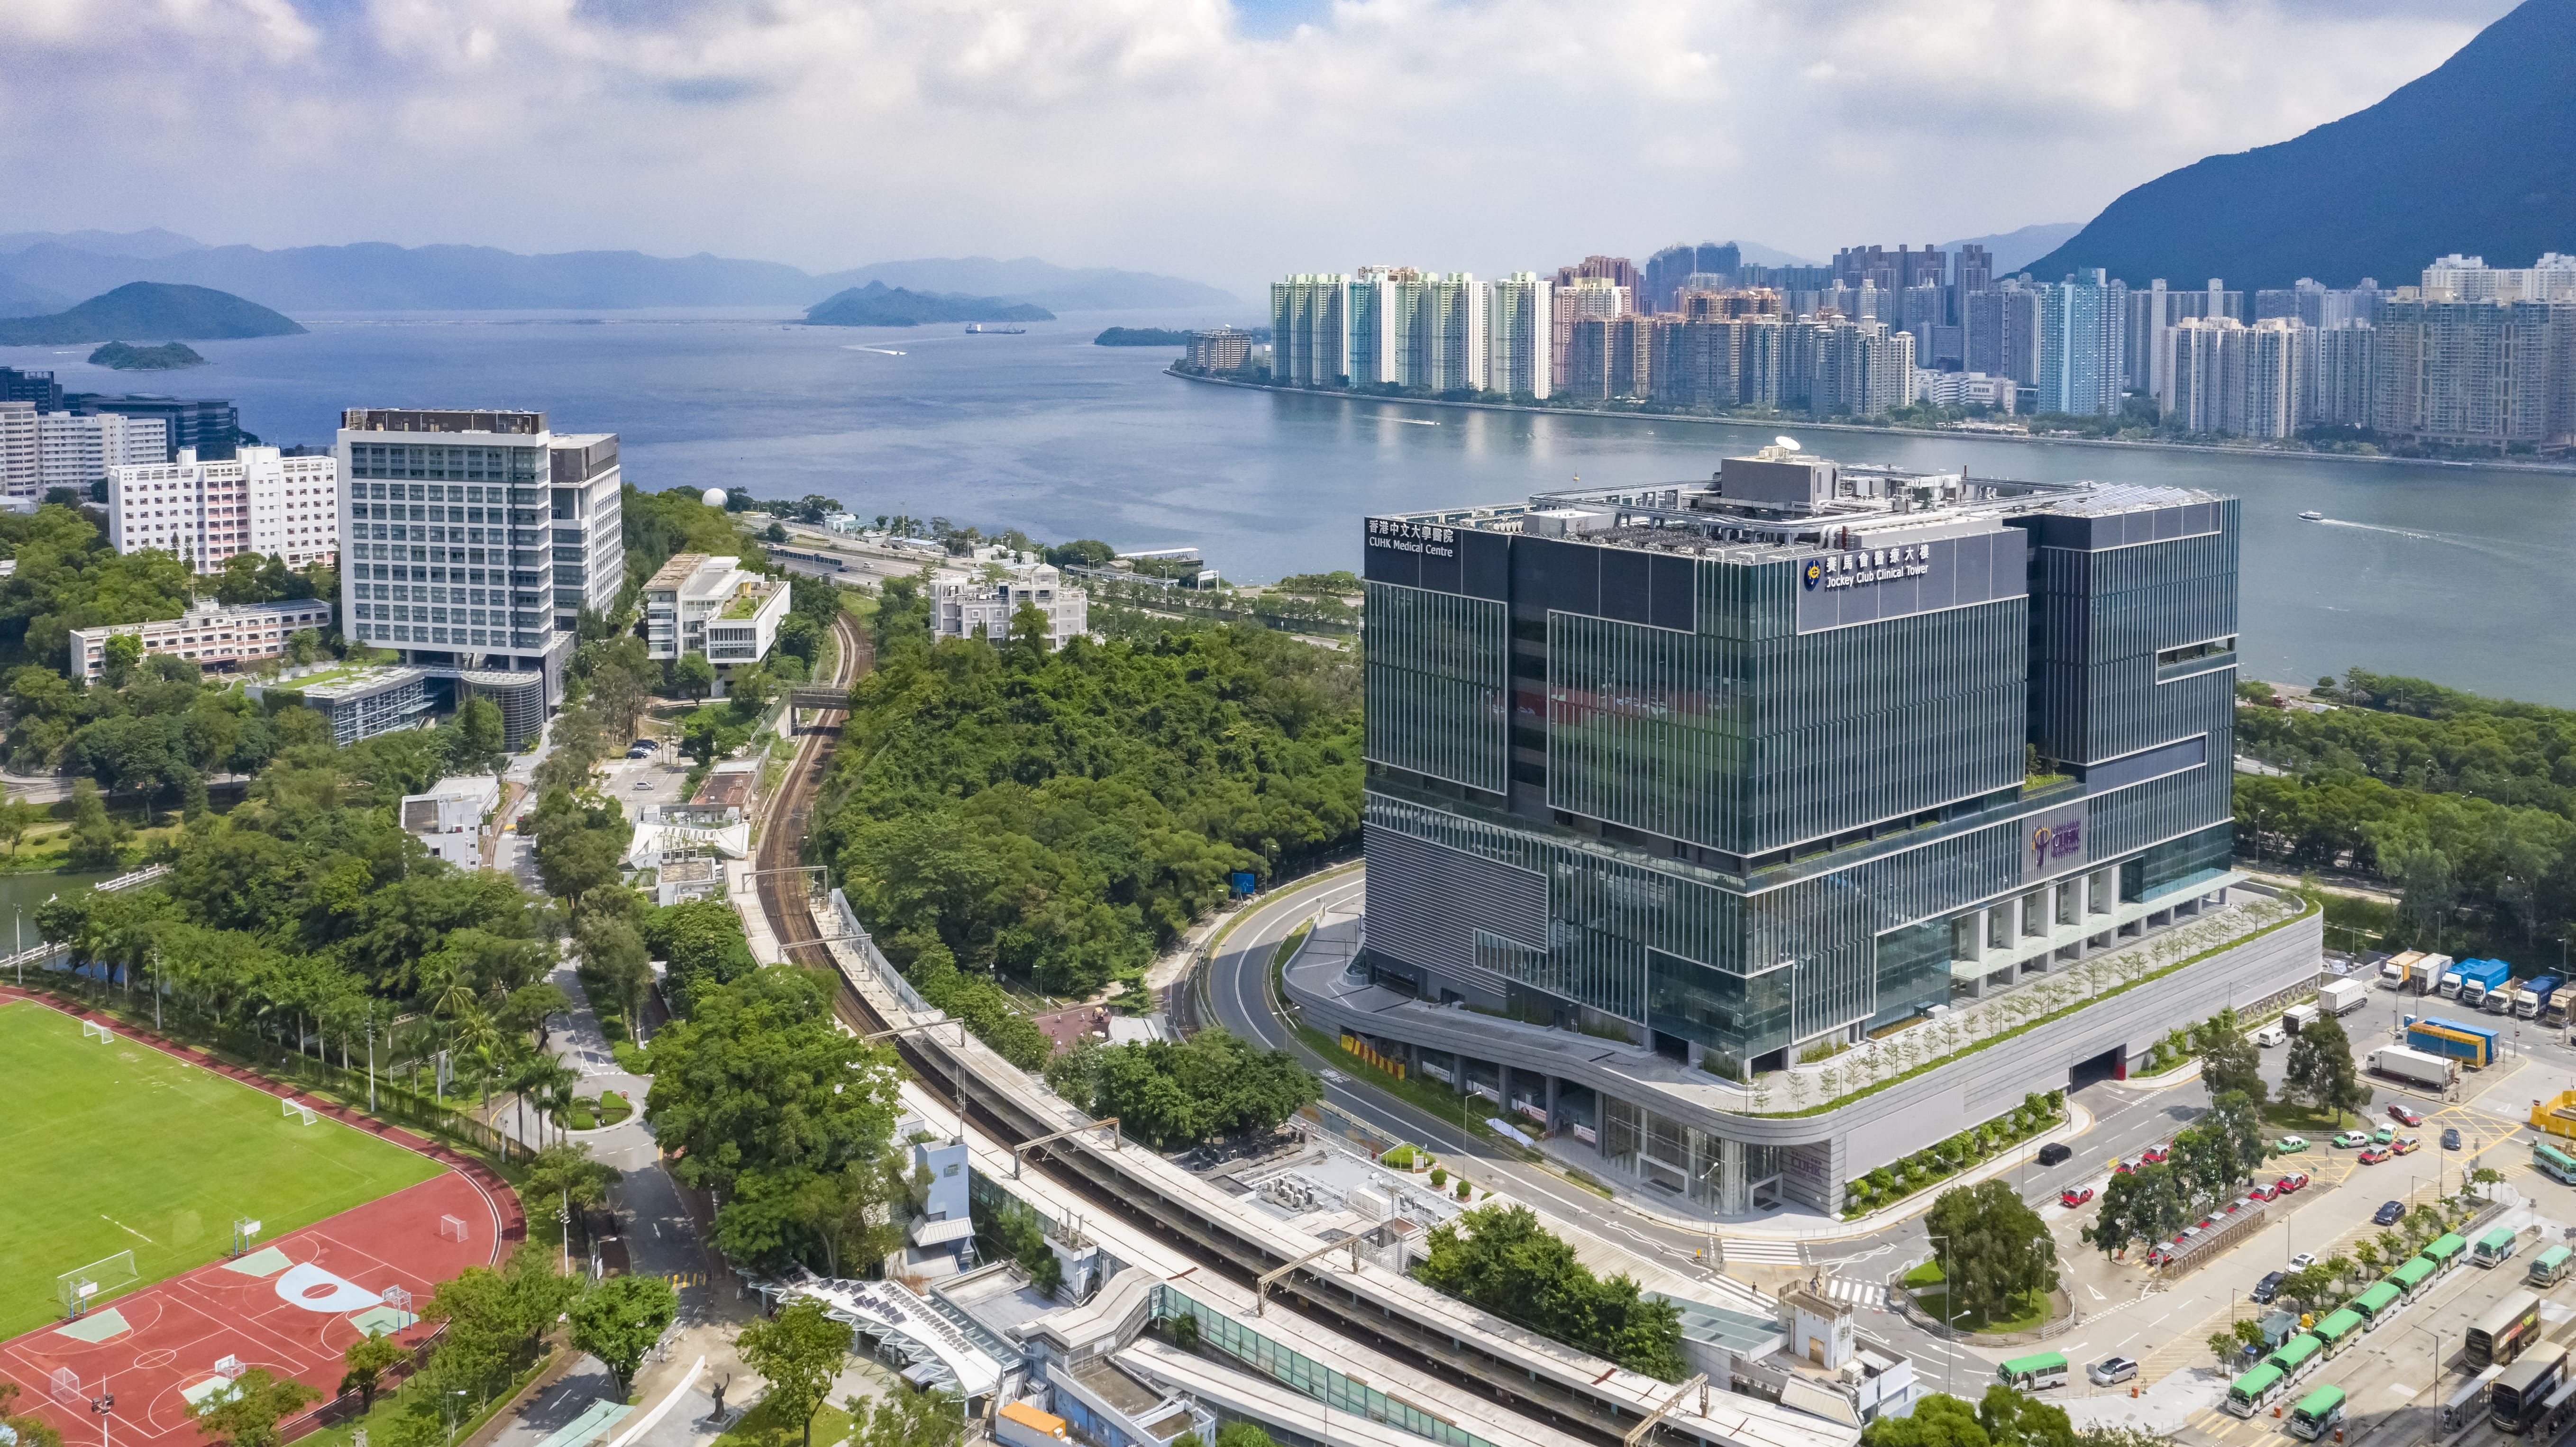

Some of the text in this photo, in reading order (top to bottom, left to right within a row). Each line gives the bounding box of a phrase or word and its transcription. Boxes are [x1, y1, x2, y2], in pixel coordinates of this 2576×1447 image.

[1369, 520, 1453, 543] 香港中文大學醫院
[1369, 537, 1453, 557] CUHK Medical Centre
[1826, 544, 1929, 573] 賽馬會醫療大樓
[1827, 564, 1929, 588] Jockey Club Clinical Tower
